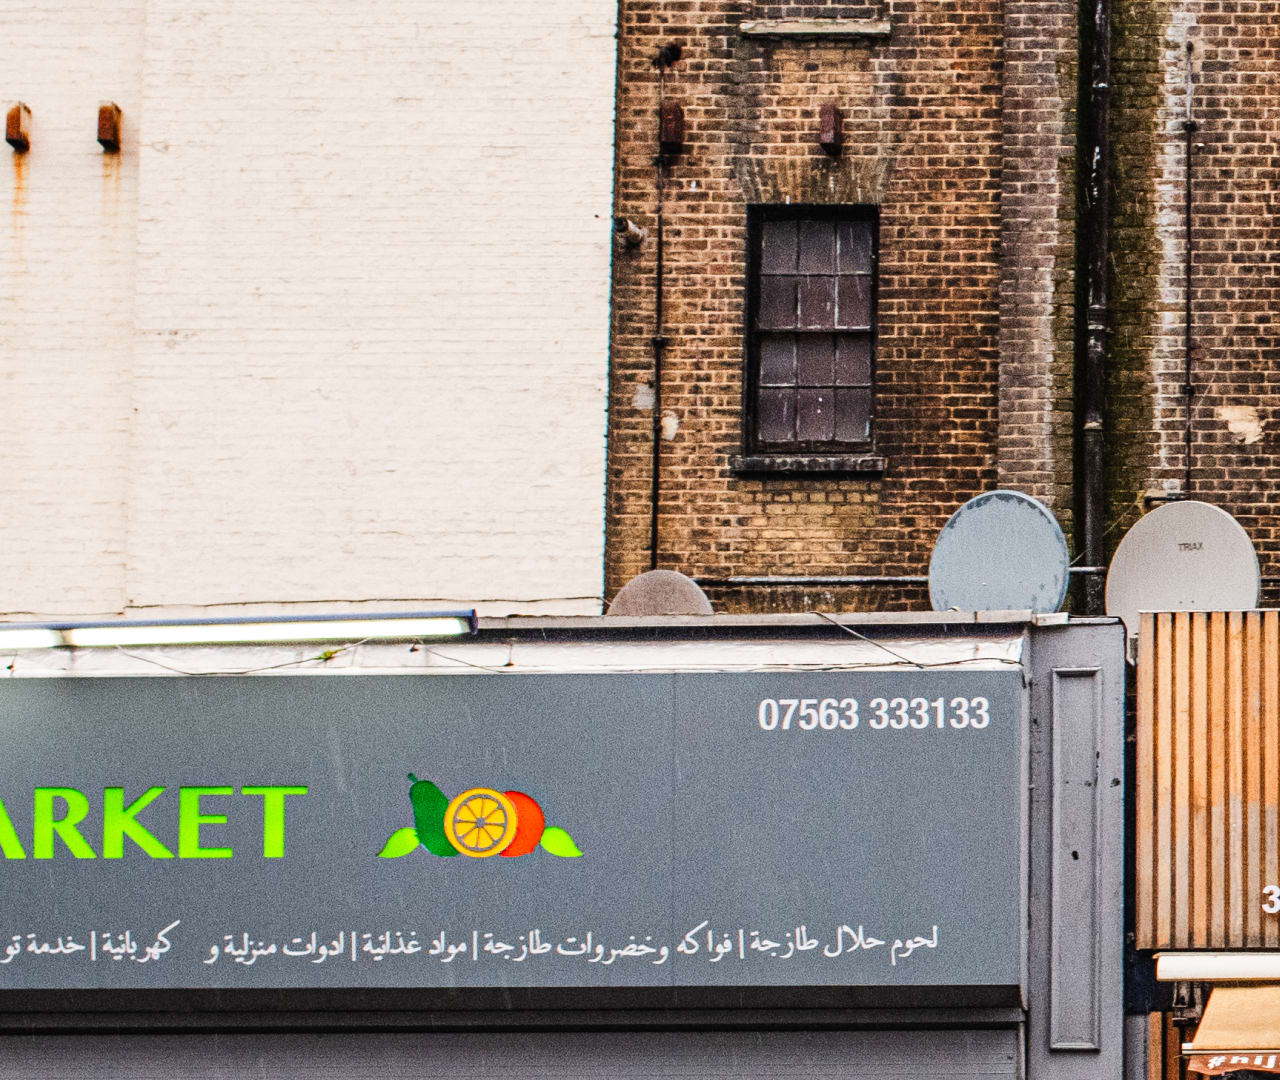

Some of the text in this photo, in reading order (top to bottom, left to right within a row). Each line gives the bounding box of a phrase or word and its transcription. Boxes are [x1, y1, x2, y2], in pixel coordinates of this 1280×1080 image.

[758, 697, 991, 731] 07563 333133
[27, 934, 86, 956] خدمة
[224, 933, 278, 967] منزلية
[429, 930, 469, 964] مواد
[483, 929, 553, 963] طازجة
[750, 925, 820, 961] طازجة
[824, 925, 887, 959] حلال
[891, 925, 940, 967] لحوم
